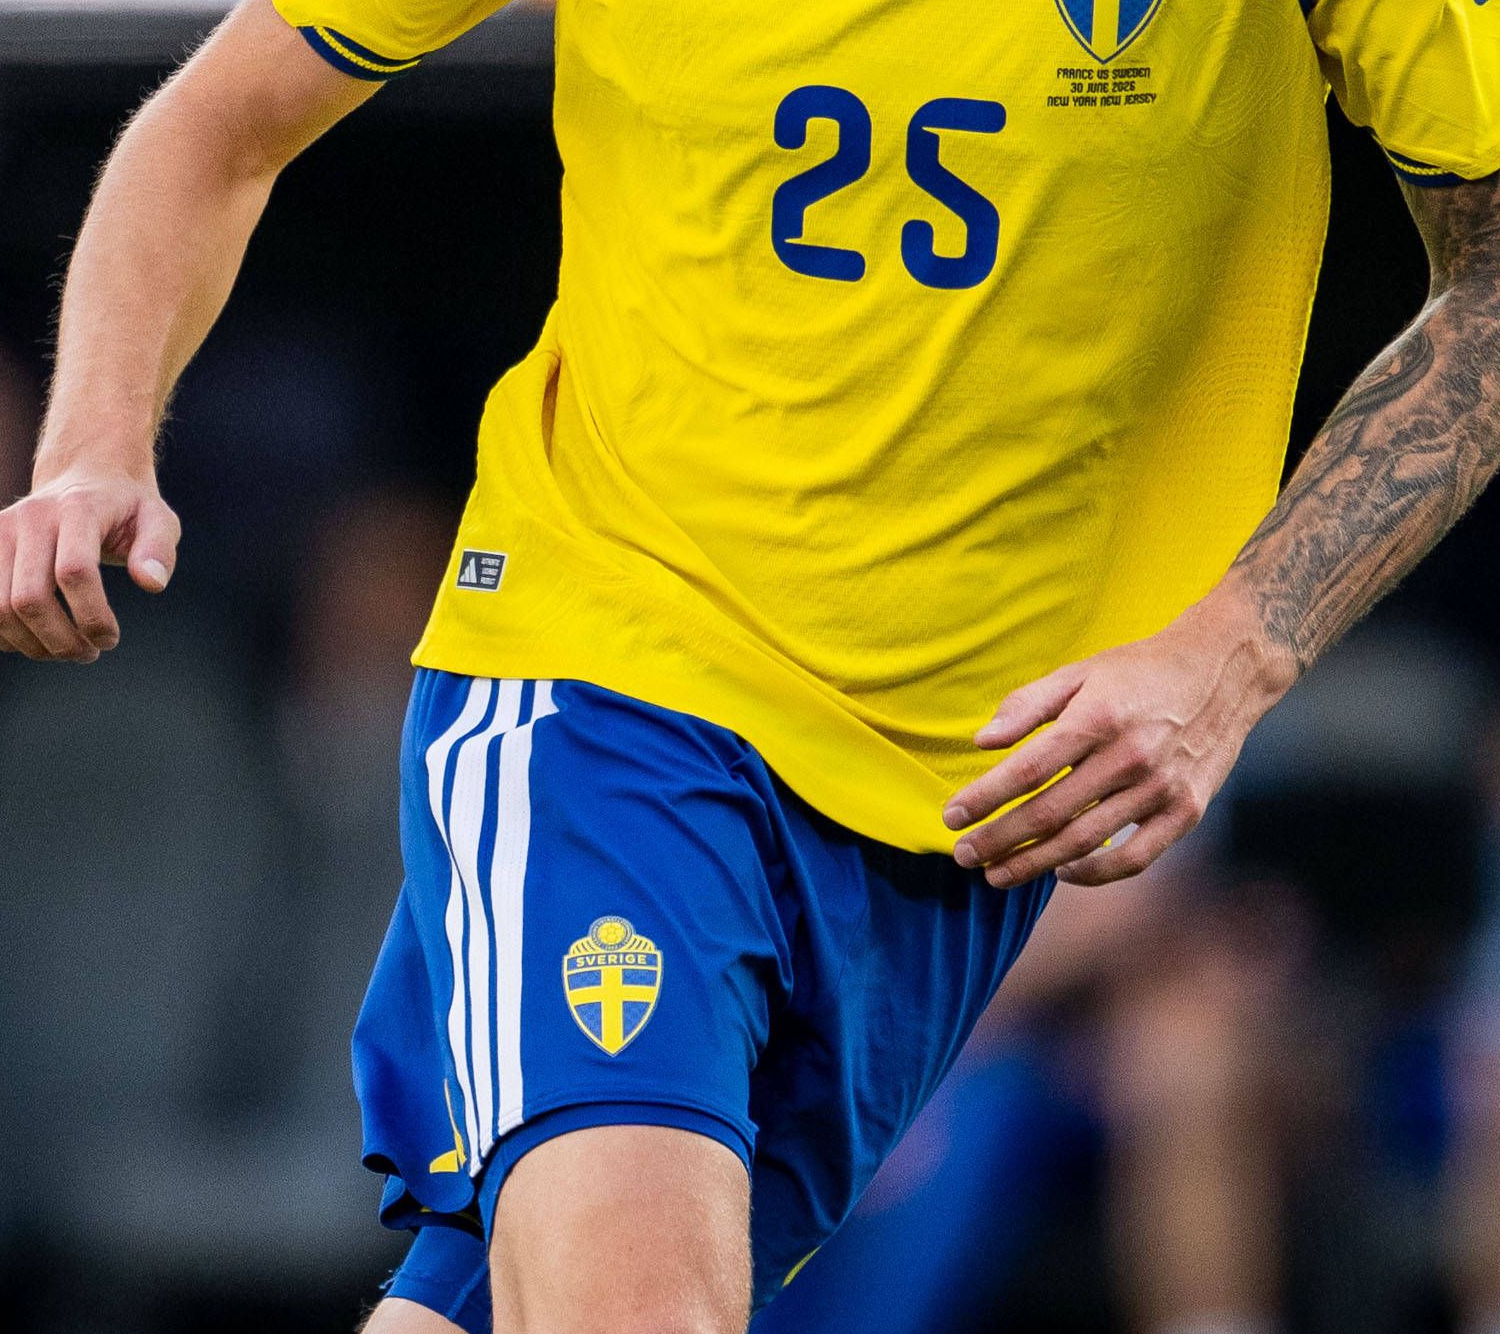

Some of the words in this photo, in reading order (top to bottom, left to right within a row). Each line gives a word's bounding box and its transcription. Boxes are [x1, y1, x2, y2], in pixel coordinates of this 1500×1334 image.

[1057, 67, 1094, 80] FRANCE
[1112, 67, 1151, 80] SWEDEN
[1070, 82, 1083, 93] 30
[1087, 82, 1109, 93] JUNE
[1111, 81, 1136, 92] 2026
[1047, 95, 1069, 107] NEW
[1072, 96, 1097, 107] YORK
[1100, 95, 1121, 107] NEW
[1124, 93, 1157, 106] JERSEY
[771, 85, 1006, 290] 25
[575, 953, 647, 968] SVERIGE
